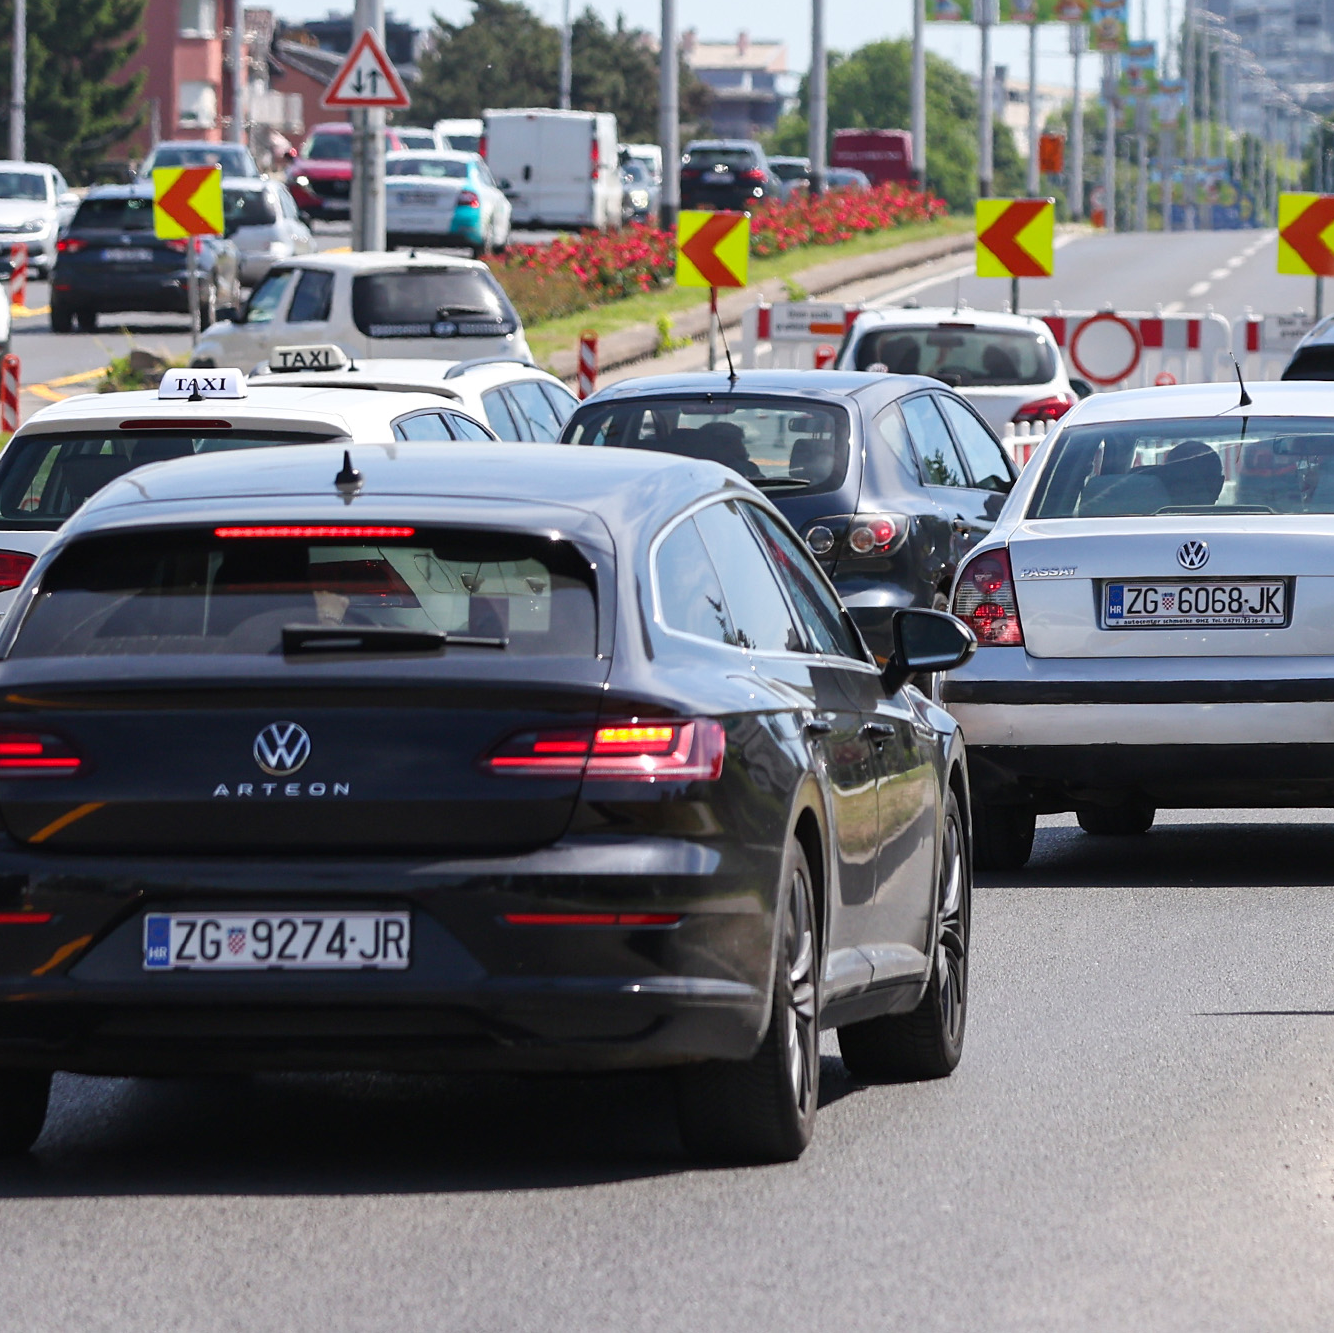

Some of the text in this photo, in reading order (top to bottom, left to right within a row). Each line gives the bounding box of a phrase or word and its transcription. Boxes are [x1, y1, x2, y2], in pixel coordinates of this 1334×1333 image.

[278, 350, 330, 367] TAXI
[175, 377, 227, 392] TAXI
[1020, 566, 1078, 578] PASSAT
[1109, 605, 1122, 615] HR
[1126, 587, 1159, 615] ZG
[213, 782, 350, 797] ARTEON
[148, 945, 168, 961] HR
[175, 919, 222, 961] ZG
